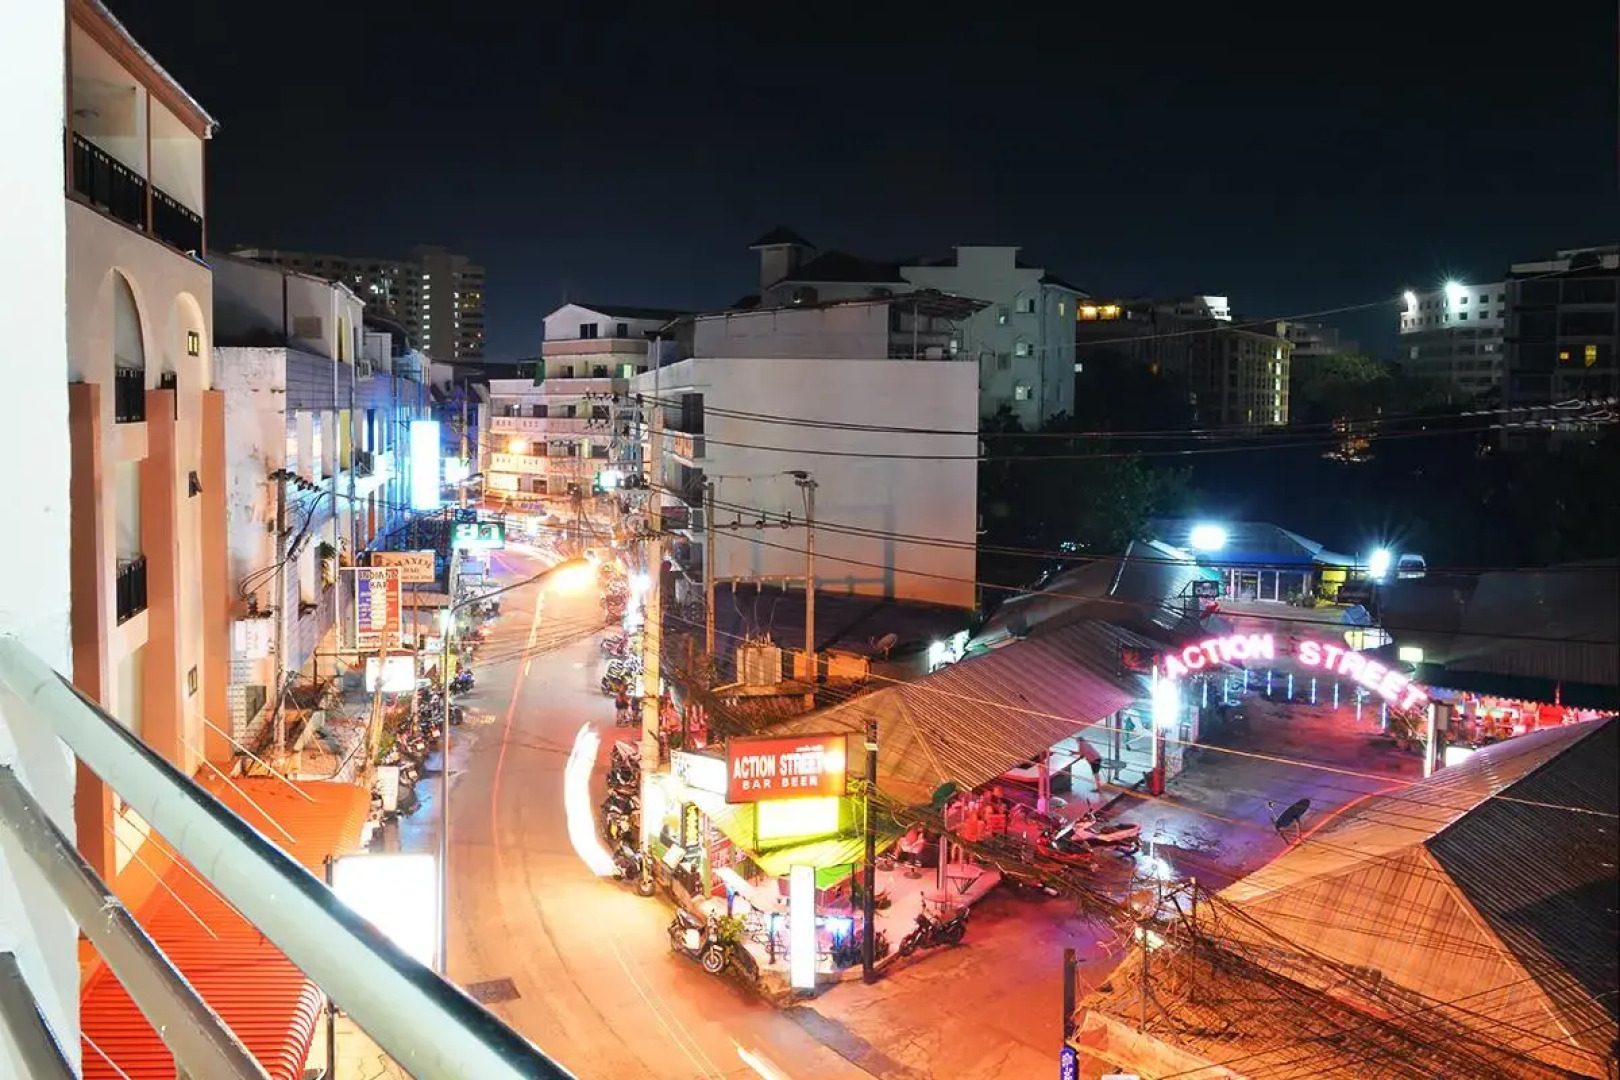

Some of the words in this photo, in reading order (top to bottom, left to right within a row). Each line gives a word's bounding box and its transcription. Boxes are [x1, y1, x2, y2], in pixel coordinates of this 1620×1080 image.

[1164, 634, 1274, 679] ACTION
[1299, 640, 1428, 710] STREET
[734, 755, 776, 779] ACTION
[779, 752, 824, 776] STREET
[743, 779, 771, 789] BAR
[781, 776, 818, 788] BEER
